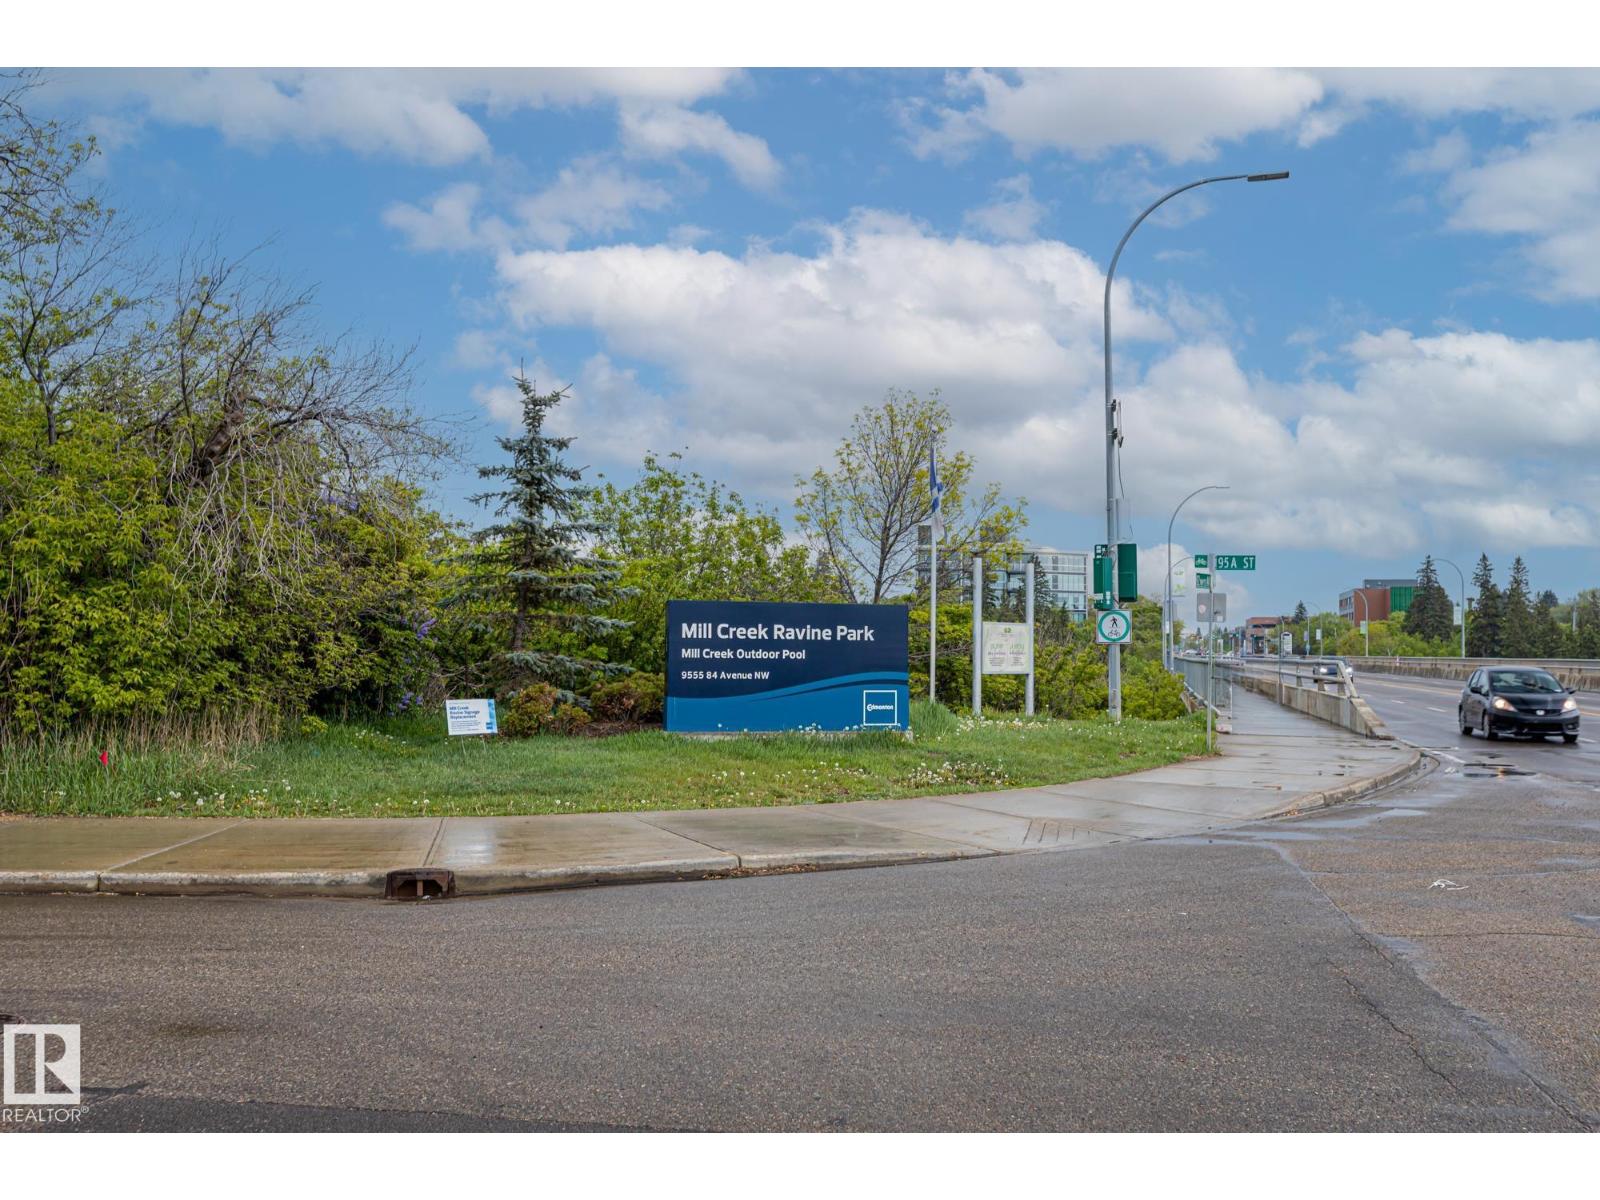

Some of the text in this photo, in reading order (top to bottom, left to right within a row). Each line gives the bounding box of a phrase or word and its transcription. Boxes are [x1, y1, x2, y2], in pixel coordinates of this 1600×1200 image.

[1218, 557, 1255, 569] 95A ST
[681, 622, 875, 642] Mill Creek Ravine Park
[681, 648, 806, 660] Mill Creek Outdoor Pool
[681, 671, 770, 680] 9555 84 Avenue NW
